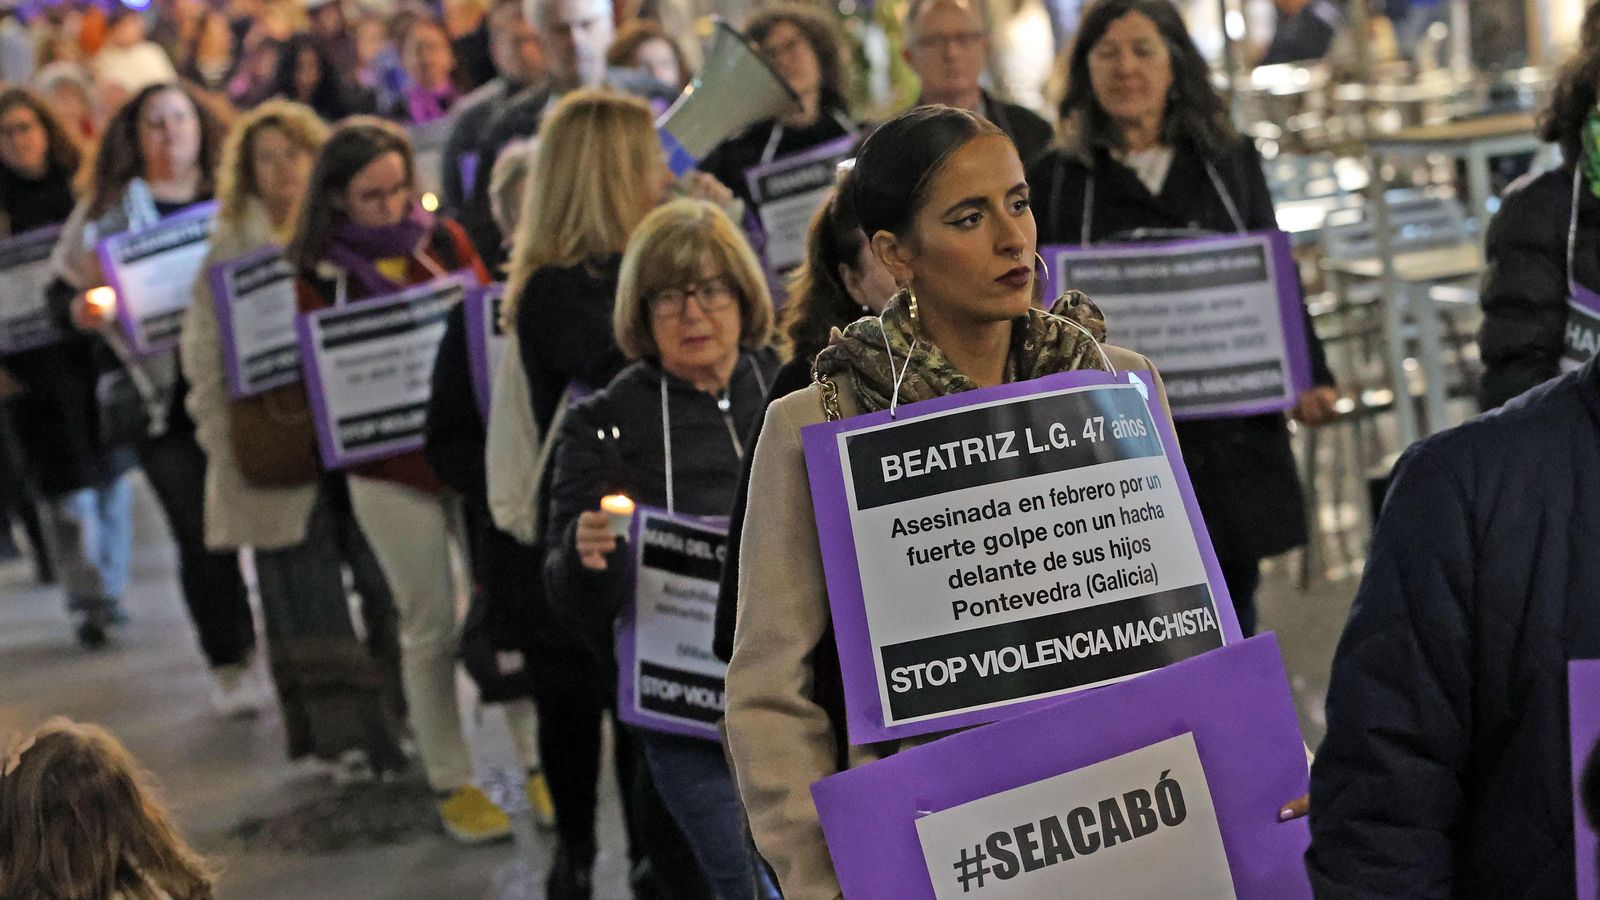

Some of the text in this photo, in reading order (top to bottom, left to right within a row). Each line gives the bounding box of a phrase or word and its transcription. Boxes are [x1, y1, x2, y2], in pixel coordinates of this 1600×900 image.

[880, 413, 1147, 483] BEATRIZ L.G. 47 años
[891, 473, 1163, 538] Asesinada en febrero por un
[906, 502, 1165, 567] fuerte golpe con un hacha
[685, 538, 715, 560] DEL
[948, 534, 1152, 590] delante de sus hijos
[952, 562, 1159, 621] Pontevedra (Galicia)
[890, 606, 1217, 694] STOP VIOLENCIA MACHISTA
[639, 675, 681, 702] STOP
[953, 769, 1187, 893] #SEACABÓ
